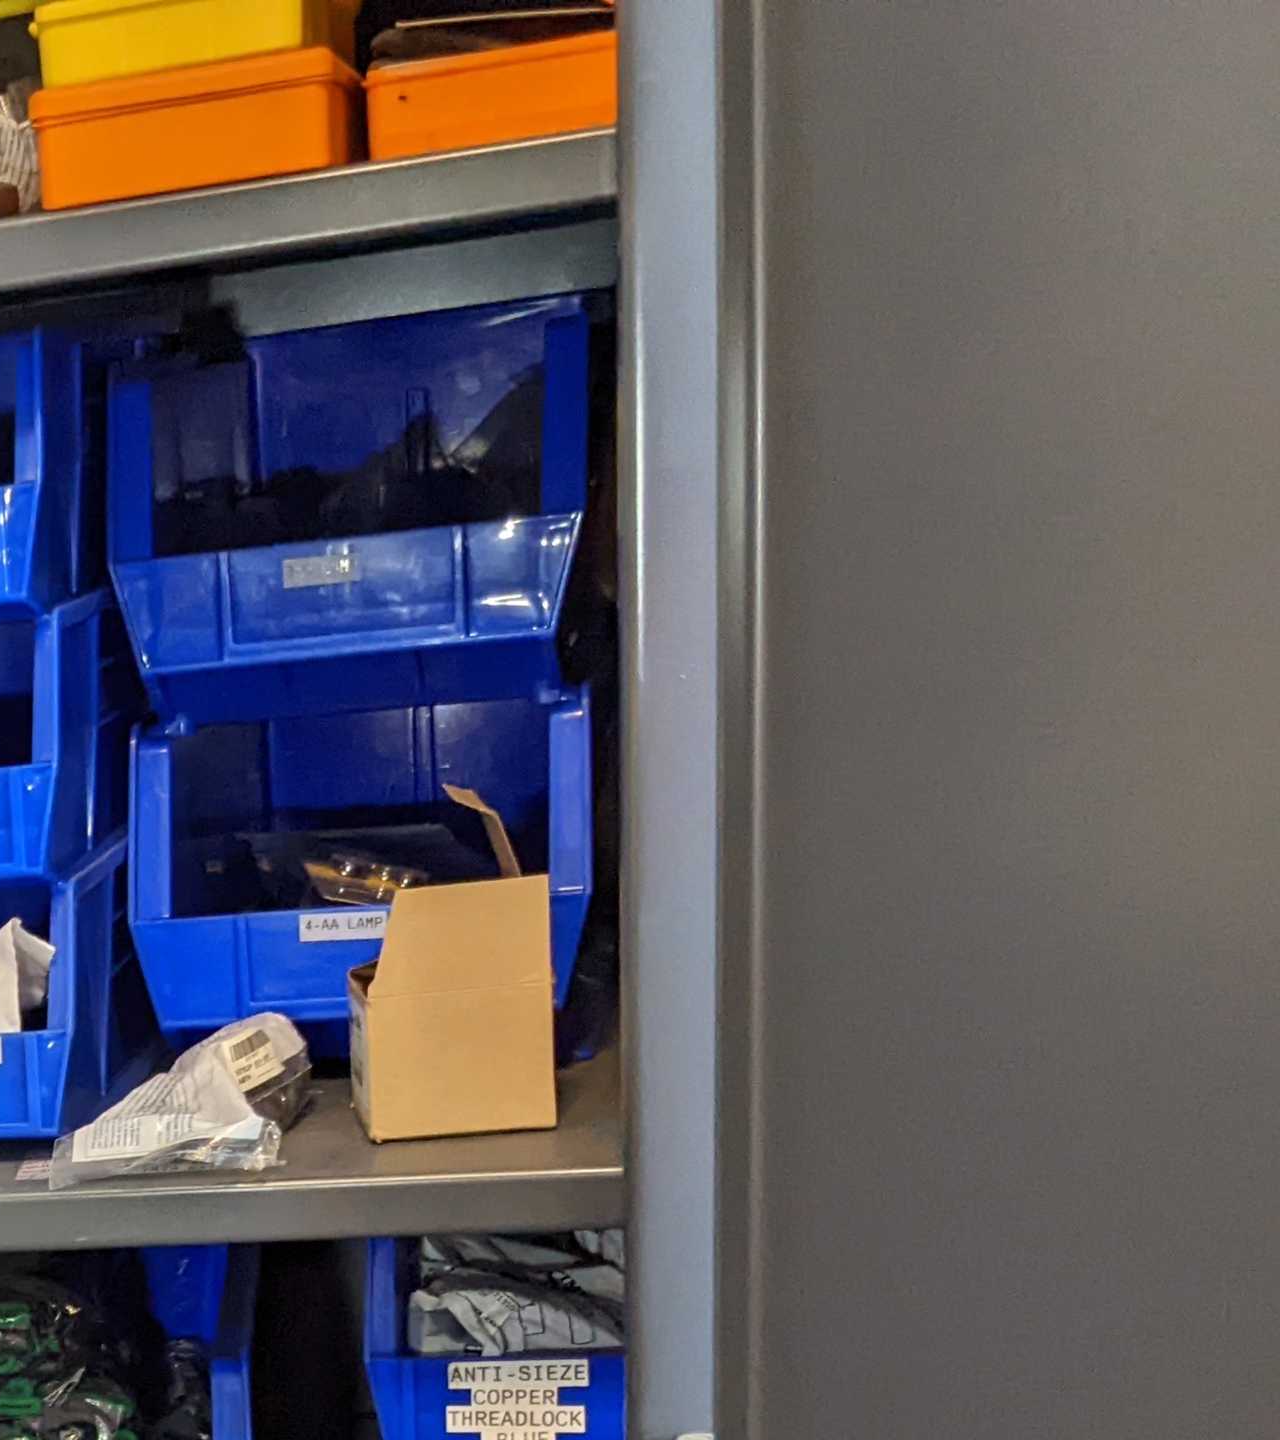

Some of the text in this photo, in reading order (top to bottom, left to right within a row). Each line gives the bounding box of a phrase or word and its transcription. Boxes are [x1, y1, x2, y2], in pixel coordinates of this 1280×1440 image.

[305, 918, 340, 931] 4-AA
[451, 1364, 585, 1382] ANTI-SIEZE
[474, 1389, 555, 1405] COPPER
[448, 1411, 582, 1427] THREADLOCK
